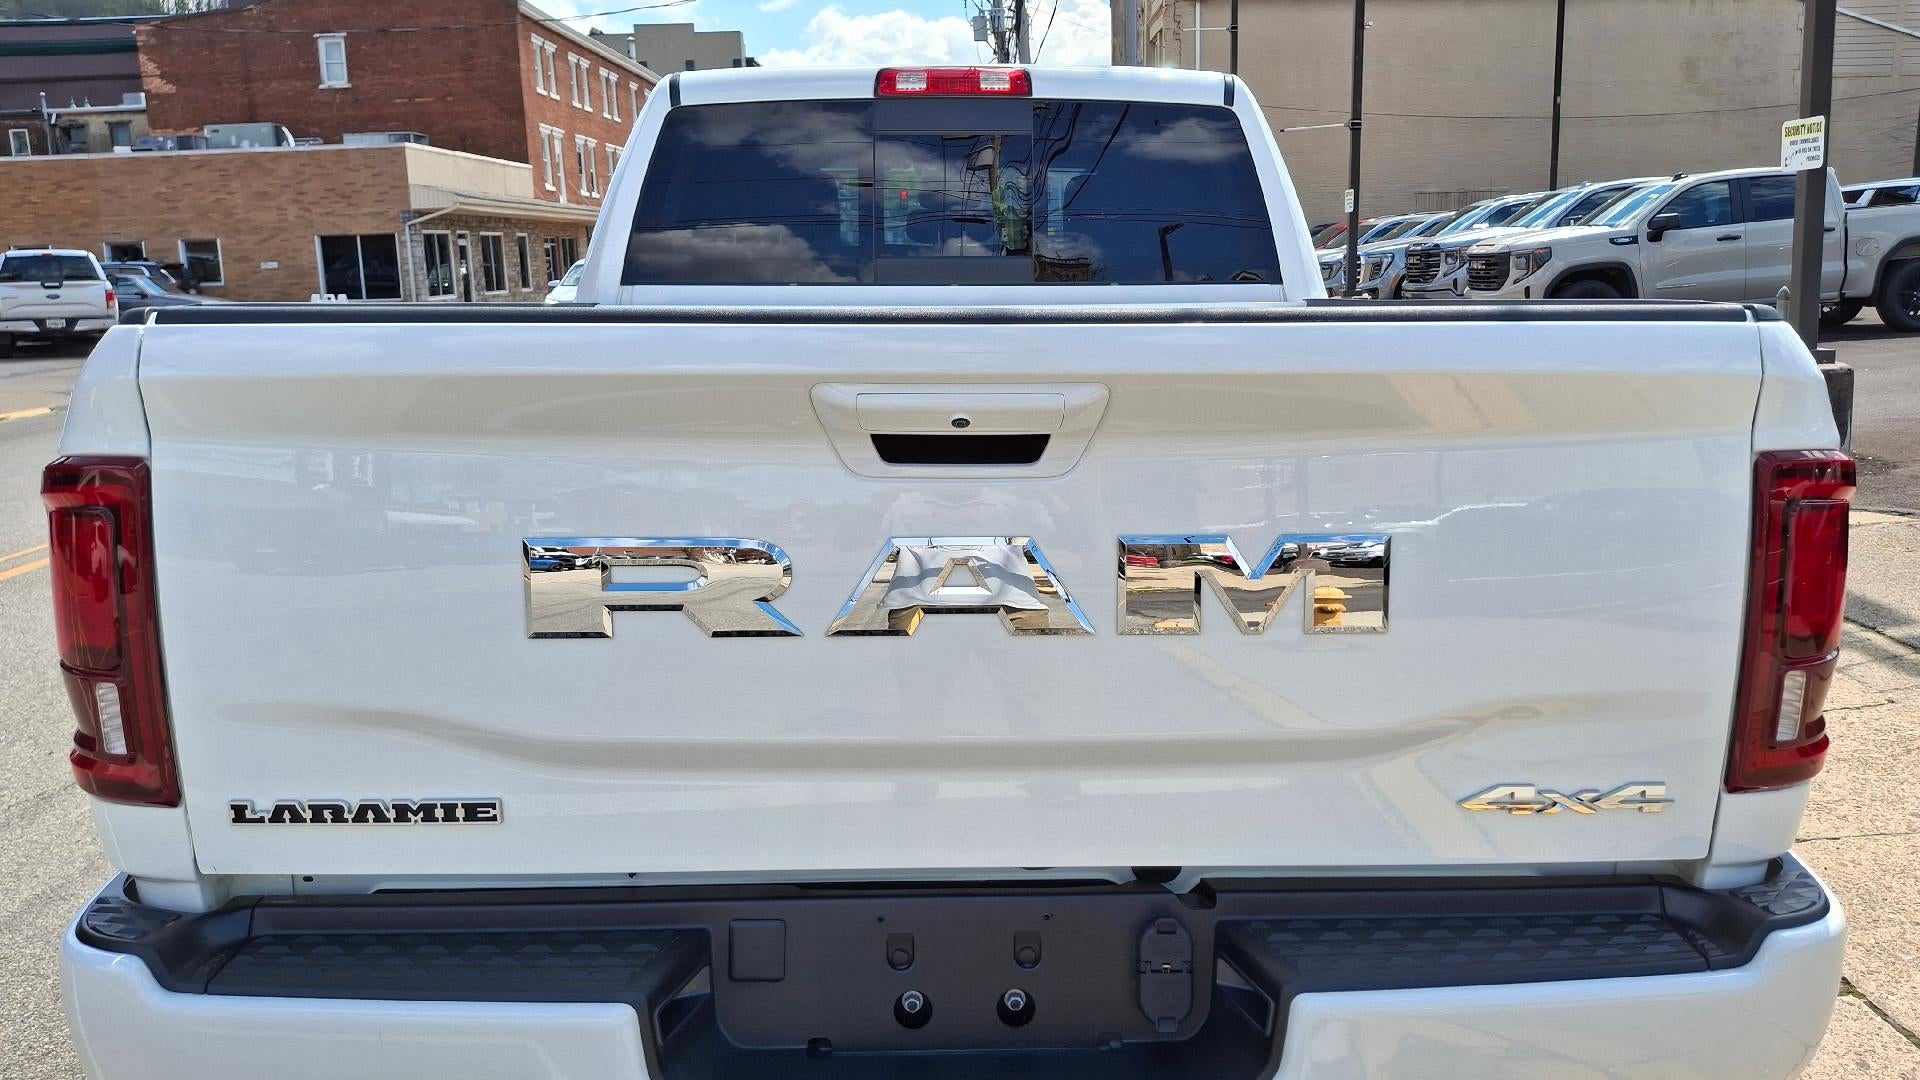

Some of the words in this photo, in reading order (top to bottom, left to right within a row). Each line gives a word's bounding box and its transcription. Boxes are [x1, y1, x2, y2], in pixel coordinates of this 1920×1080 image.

[1785, 124, 1806, 137] SECURITY
[523, 534, 1392, 637] RAM
[229, 800, 503, 825] LARAMIE
